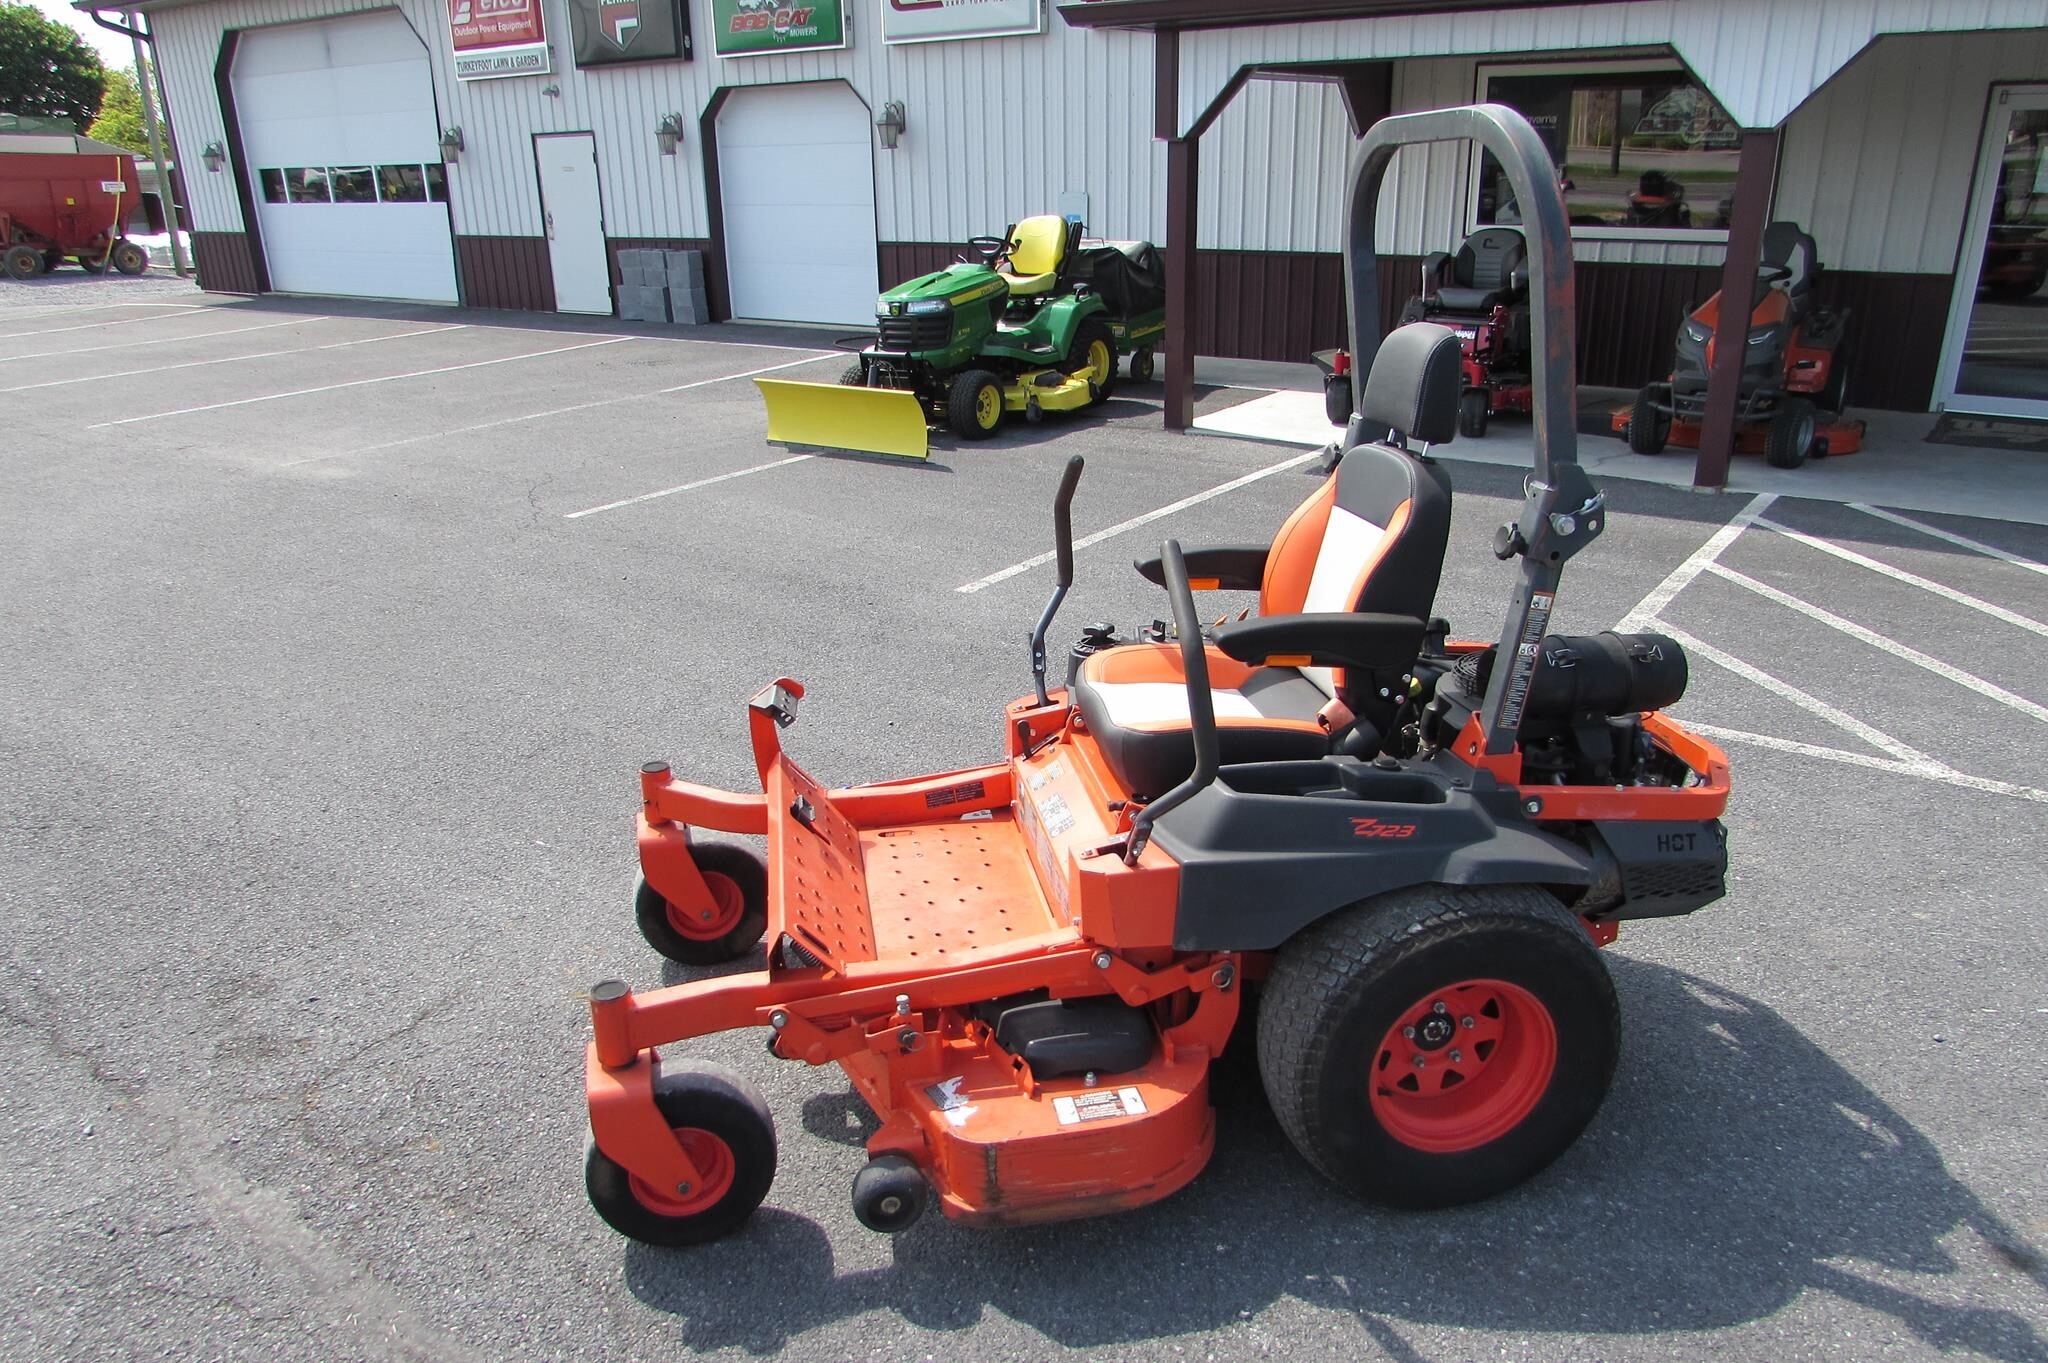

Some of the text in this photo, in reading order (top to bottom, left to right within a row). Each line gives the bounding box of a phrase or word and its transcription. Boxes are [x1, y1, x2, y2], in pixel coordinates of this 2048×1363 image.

[454, 19, 532, 36] Outdoor Power Equipment
[790, 26, 818, 37] MOWERS
[457, 59, 492, 73] TURKEYFOOT
[493, 57, 510, 69] LAWN
[515, 54, 540, 67] GARDEN
[1351, 817, 1417, 837] Z723
[1656, 832, 1696, 853] HOT
